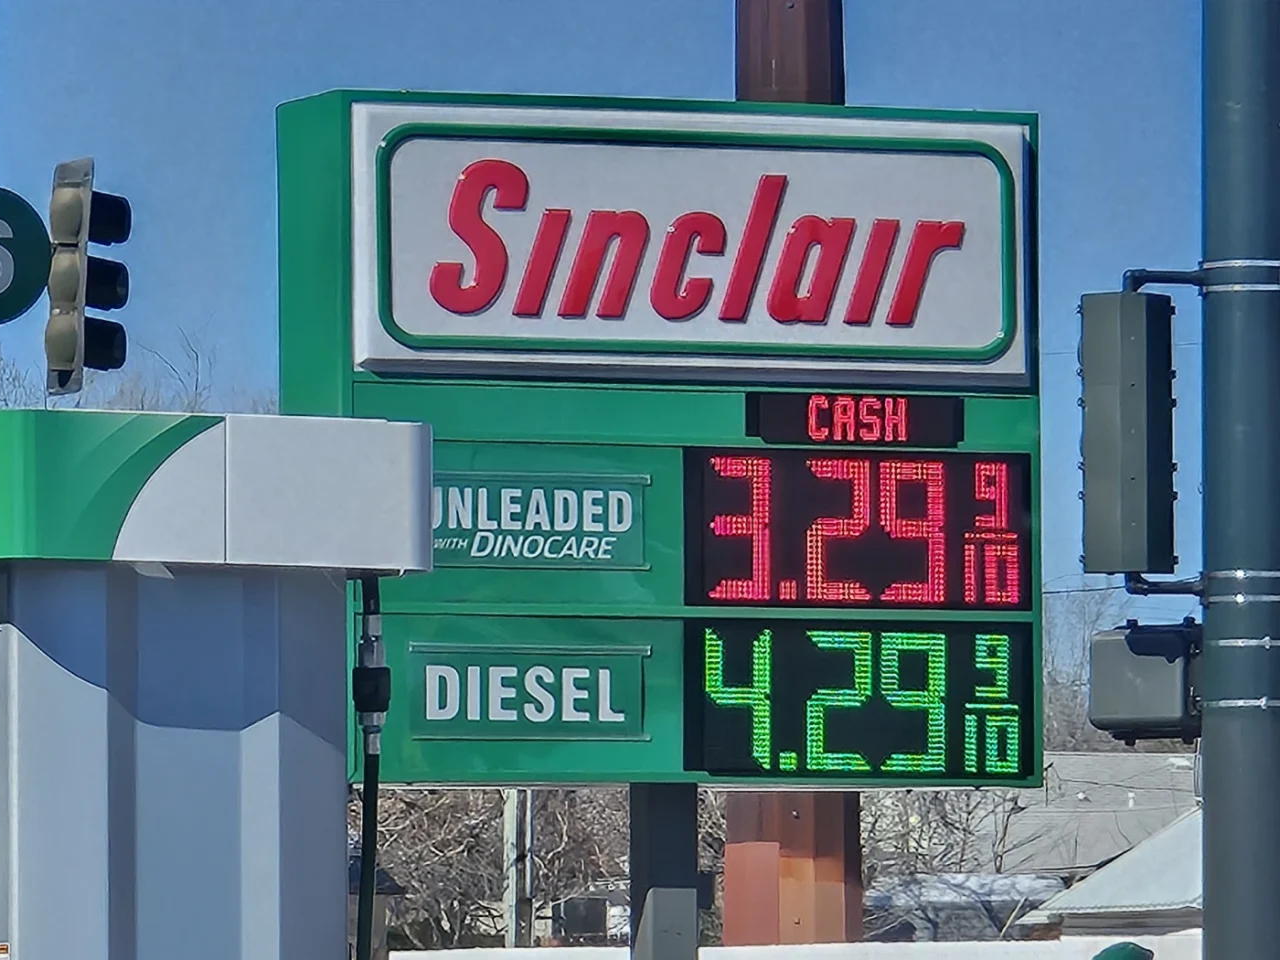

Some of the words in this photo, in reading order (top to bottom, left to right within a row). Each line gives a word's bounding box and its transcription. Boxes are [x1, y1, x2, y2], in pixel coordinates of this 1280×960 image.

[429, 159, 966, 327] Sinclair
[808, 394, 909, 442] CASH
[470, 531, 617, 559] DINOCARE
[709, 456, 946, 603] 3.29
[975, 461, 1009, 530] 9
[425, 663, 626, 723] DIESEL
[705, 628, 947, 773] 4.29
[975, 634, 1010, 699] 9
